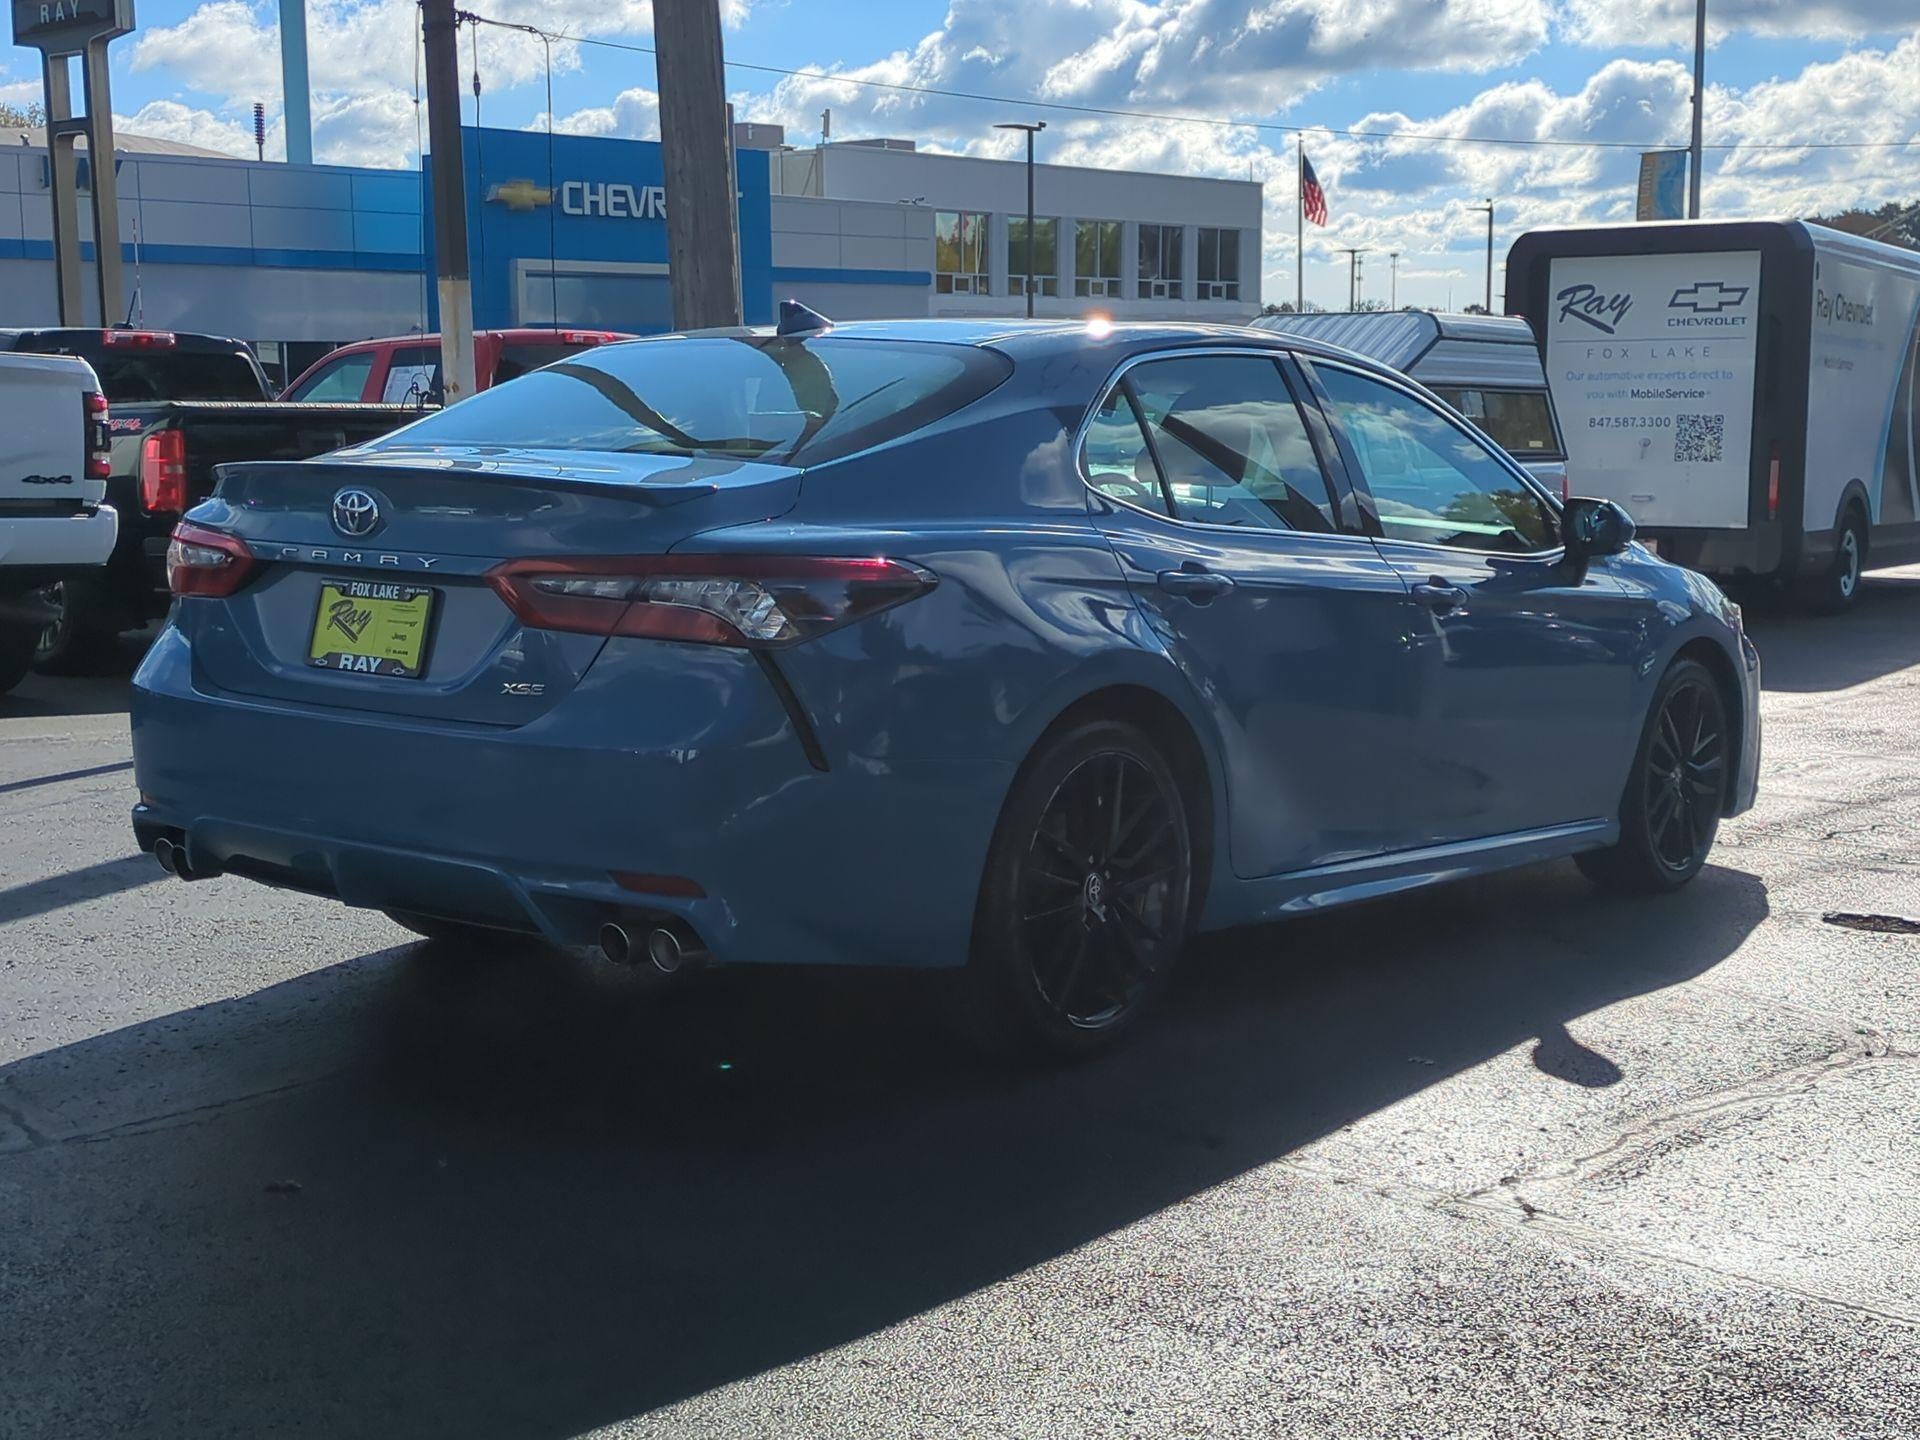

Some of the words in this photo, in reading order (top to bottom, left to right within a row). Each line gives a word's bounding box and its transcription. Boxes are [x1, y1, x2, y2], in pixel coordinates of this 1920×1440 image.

[40, 0, 80, 24] RAY
[1556, 284, 1633, 334] Ray
[1667, 316, 1747, 327] CHEVROLET
[1586, 348, 1630, 359] FOX
[1651, 346, 1711, 358] LAKE
[1566, 370, 1584, 381] Our
[1587, 370, 1643, 381] automotive
[1647, 370, 1686, 382] experts
[1688, 369, 1719, 380] direct
[1721, 370, 1734, 380] to
[1585, 390, 1604, 400] you
[1606, 388, 1628, 398] with
[1588, 416, 1671, 428] 847.587.3300
[282, 547, 439, 568] CAMRY
[350, 582, 371, 597] FOX
[372, 583, 400, 600] LAKE
[326, 599, 373, 644] Ray
[338, 653, 383, 673] RAY
[501, 681, 545, 696] XSE
